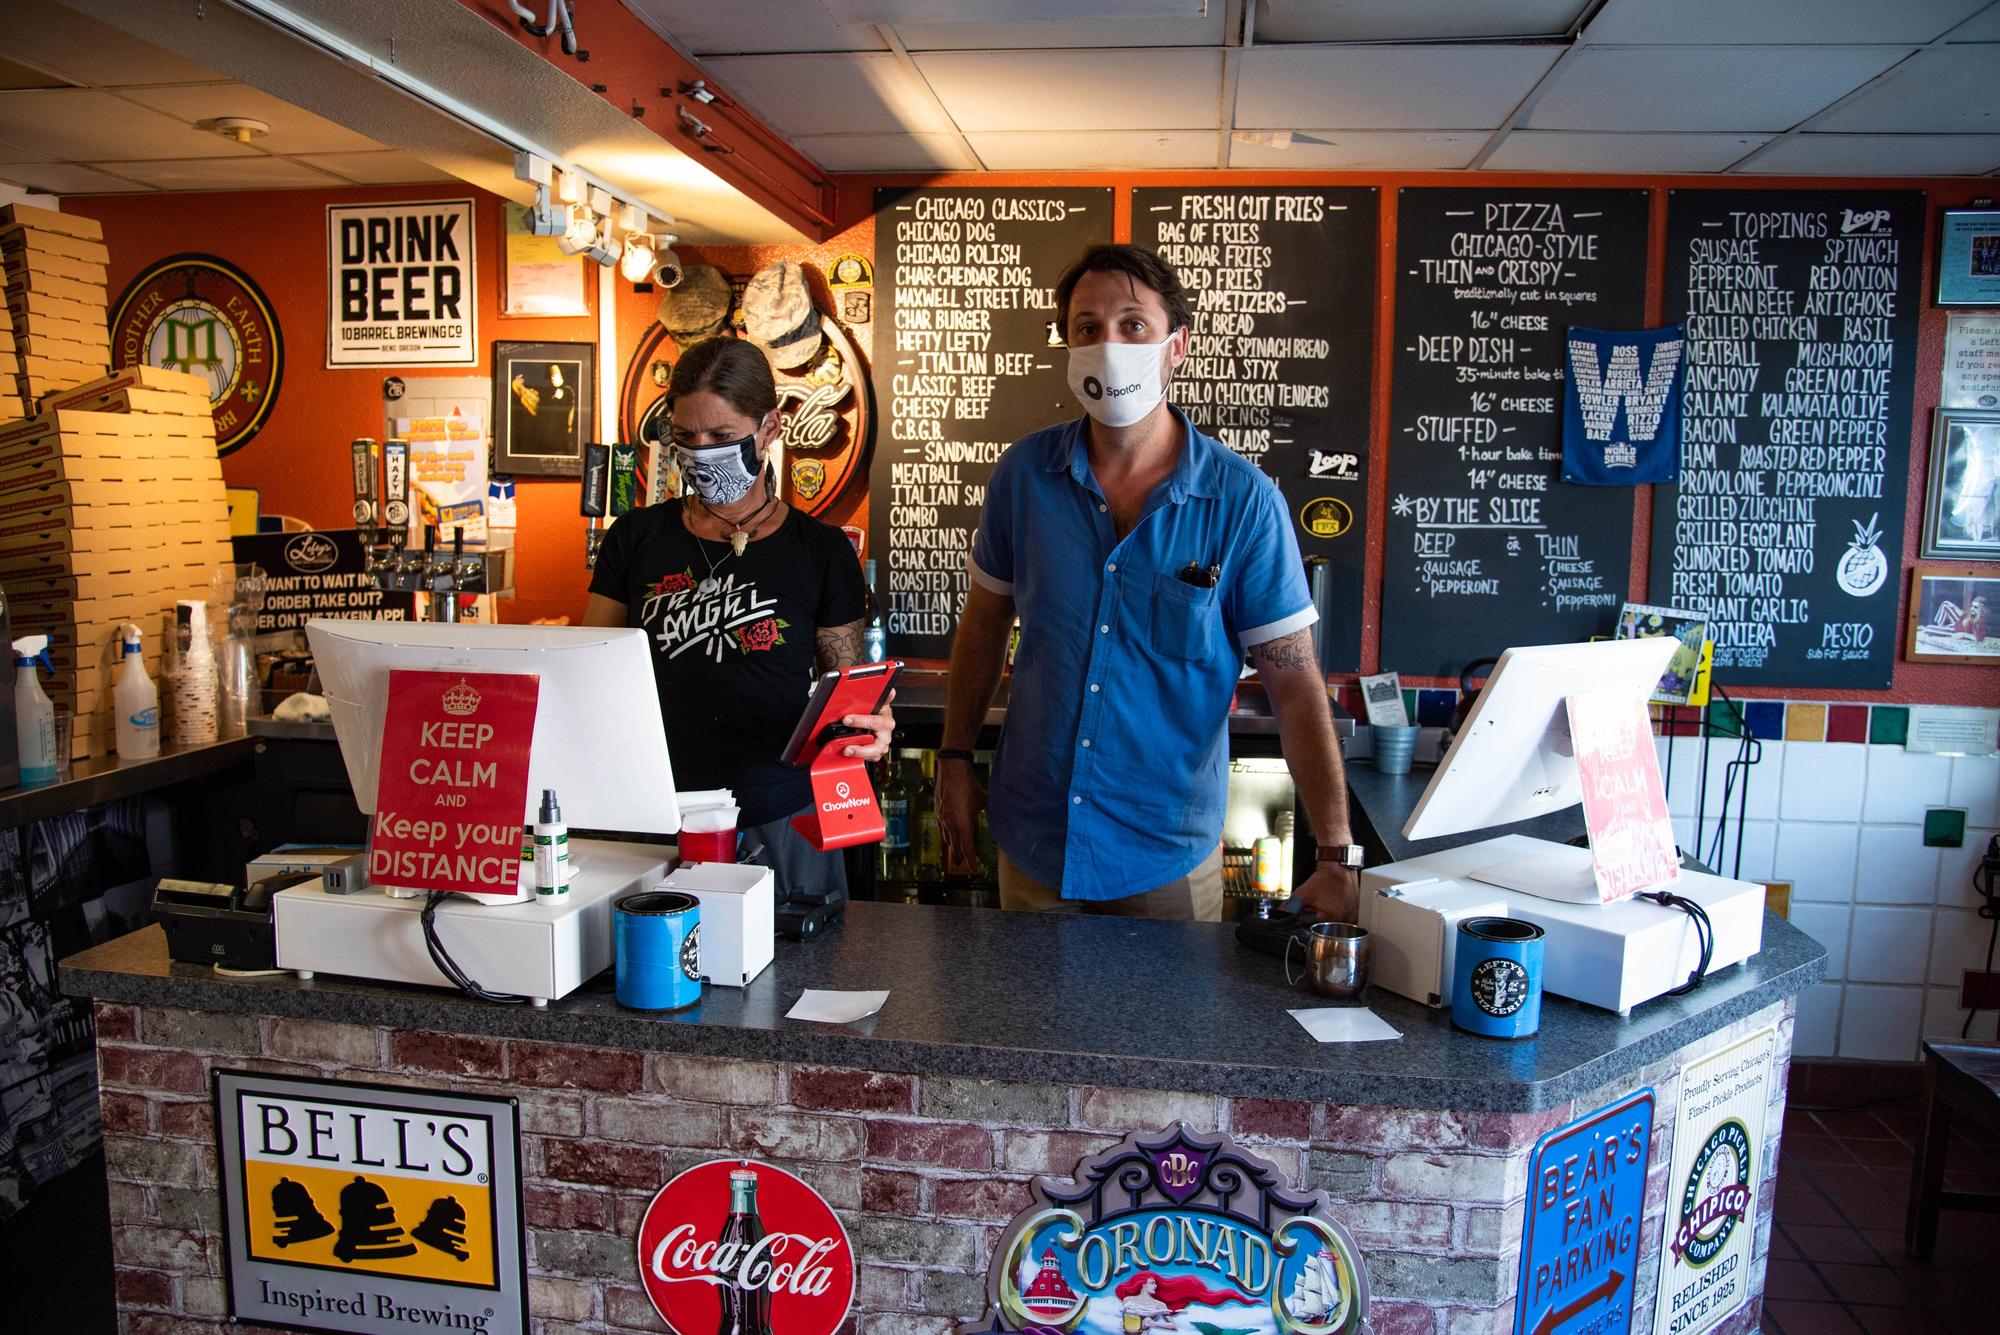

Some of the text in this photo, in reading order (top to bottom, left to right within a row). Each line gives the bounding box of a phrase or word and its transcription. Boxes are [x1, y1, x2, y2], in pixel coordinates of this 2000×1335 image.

[915, 197, 1066, 221] CHICAGO CLASSICS
[1181, 196, 1324, 222] FRESH CUT FRIES
[1486, 203, 1565, 232] PIZZA
[896, 222, 995, 242] CHICAGO DOG
[1158, 222, 1259, 244] BAG FRIES
[1730, 212, 1828, 239] TOPPINGS
[341, 214, 460, 264] DRINK
[896, 244, 1021, 265] CHICAGO POLISH
[1225, 247, 1272, 267] FRIES
[1003, 268, 1031, 287] DOG
[1216, 269, 1263, 291] FRIES
[1475, 260, 1563, 285] AND CRISPY
[341, 266, 461, 322] BEER
[965, 289, 1019, 309] STREET
[1520, 289, 1597, 305] cut in squares
[1757, 291, 1795, 315] BEEF
[227, 296, 262, 363] EARTH
[895, 310, 991, 330] CHAR BURGER
[1212, 313, 1254, 335] BREAD
[1500, 316, 1549, 331] CHEESE
[1843, 317, 1893, 342] BASIL
[1959, 326, 1990, 335] Please
[342, 327, 352, 340] 10
[354, 327, 395, 340] BARREL
[397, 326, 446, 339] BREWING
[896, 332, 991, 352] HEFTY LEFTY
[1236, 337, 1293, 358] SPINACH
[1418, 335, 1514, 363] DEEP DISH
[1569, 340, 1596, 350] LESTER
[1613, 346, 1638, 356] ROSS
[1686, 341, 1760, 367] MEATBALL
[1796, 343, 1892, 368] MUSHROOM
[1958, 350, 1983, 358] staff
[918, 352, 1034, 376] ITALIAN BEEF
[1242, 359, 1279, 380] STYX
[1524, 366, 1550, 380] bake
[1607, 370, 1641, 379] RUSSELL
[1956, 361, 1964, 369] if
[893, 375, 996, 397] CLASSIC BEEF
[1604, 380, 1643, 389] ARRIETA
[1684, 368, 1759, 391] ANCHOVY
[1785, 368, 1891, 395] GREEN OLIVE
[1961, 373, 1979, 381] any
[1106, 382, 1142, 398] SpotOn
[1215, 383, 1328, 408] CHICKEN TENDERS
[1580, 394, 1619, 406] FOWLER
[1625, 395, 1667, 406] BRYANT
[1644, 386, 1669, 395] SMITH
[892, 398, 990, 419] CHEESY BEEF
[1501, 398, 1554, 412] CHEESE
[1683, 393, 1748, 417] SALAMI
[1842, 395, 1889, 420] OLIVE
[1583, 411, 1616, 422] LACKEY
[1628, 414, 1661, 425] RIZZO
[1417, 416, 1497, 443] STUFFED
[1587, 430, 1611, 441] BAEZ
[1628, 425, 1658, 433] STROP
[1682, 418, 1736, 444] BACON
[1769, 420, 1887, 446] GREEN PEPPER
[1506, 447, 1533, 460] bake
[1604, 447, 1636, 455] WORLD
[1604, 455, 1636, 464] SERIES
[1681, 444, 1717, 469] HAM
[1739, 446, 1886, 472] ROASTED RED PEPPER
[391, 456, 399, 492] HAZY
[892, 463, 962, 484] MEATBALL
[1498, 474, 1547, 491] CHEESE
[1679, 470, 1765, 495] PROVOLONE
[891, 485, 958, 505] ITALIAN
[890, 507, 938, 527] COMBO
[1490, 497, 1540, 523] SLICE
[1677, 498, 1816, 522] GRILLED ZUCCHINI
[1676, 522, 1817, 548] GRILLED EGGPLANT
[889, 550, 926, 569] CHAR
[1549, 561, 1594, 576] CHEESE
[1673, 546, 1814, 573] SUNDRIED TOMATO
[265, 574, 355, 591] WANT TO WAIT
[890, 572, 949, 591] ROASTED
[1672, 572, 1782, 597] FRESH TOMATO
[267, 592, 383, 610] ORDER TAKE OUT?
[889, 593, 950, 613] ITALIAN
[1751, 599, 1808, 623] GARLIC
[278, 614, 298, 628] ON
[888, 613, 949, 635] GRILLED
[1822, 623, 1874, 648] PESTO
[420, 722, 494, 749] KEEP
[410, 759, 497, 788] CALM
[1600, 768, 1648, 800] CALM
[435, 794, 466, 807] AND
[822, 797, 871, 812] ChowNow
[376, 812, 522, 849] Keep your
[372, 850, 518, 885] DISTANCE
[1479, 961, 1524, 977] LEFTY'S
[1474, 992, 1526, 1014] PIZZERIA
[1684, 1049, 1770, 1101] Proudly Serving Chicago's
[1688, 1074, 1763, 1120] Finest Pickle Products
[257, 1103, 474, 1177] BELL'S
[1160, 1152, 1199, 1188] CBC
[1542, 1123, 1642, 1211] BEAR'S
[1684, 1127, 1747, 1215] CHICAGO PICKLE
[1562, 1183, 1615, 1245] FAN
[651, 1224, 841, 1296] Coca-Cola
[1534, 1216, 1632, 1307] PARKING
[1671, 1253, 1738, 1313] RELISHED
[259, 1280, 364, 1317] Inspired
[1669, 1296, 1709, 1335] SINCE
[1712, 1278, 1735, 1307] 1925
